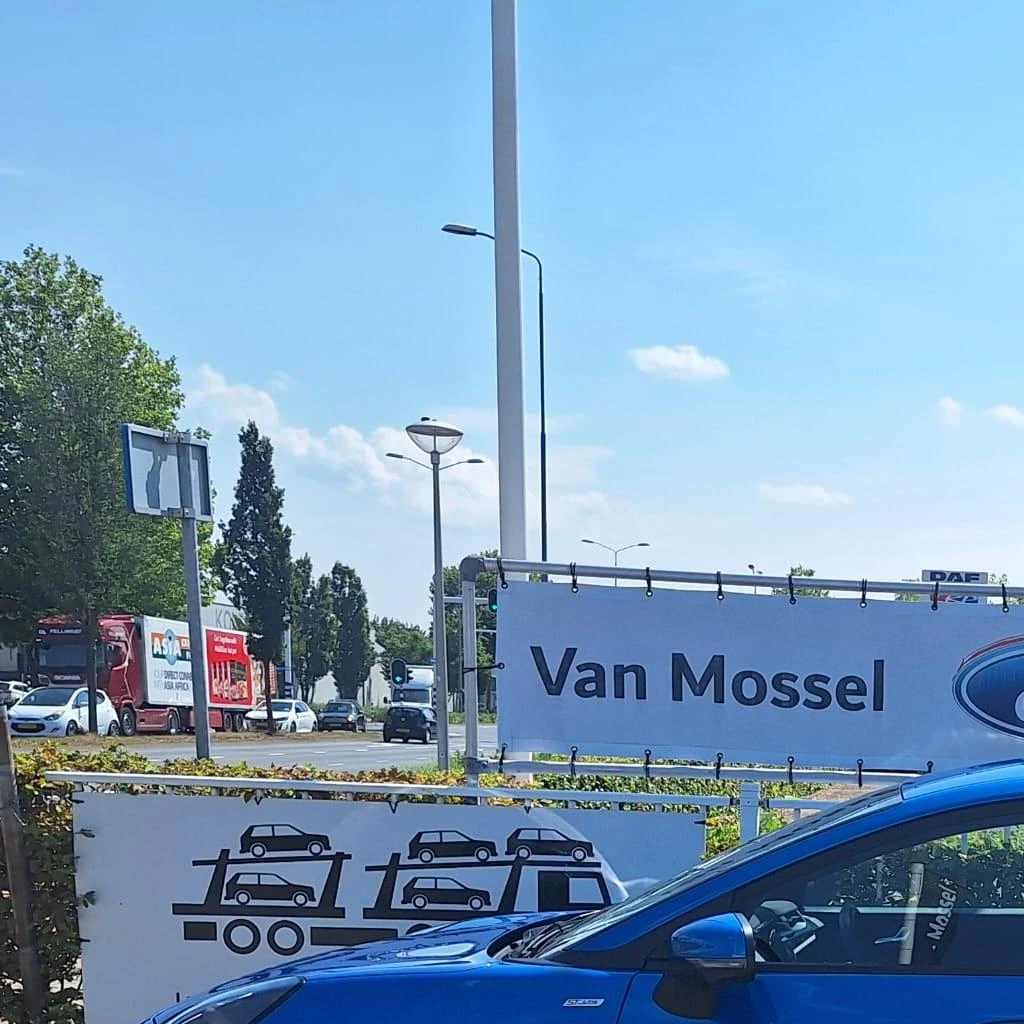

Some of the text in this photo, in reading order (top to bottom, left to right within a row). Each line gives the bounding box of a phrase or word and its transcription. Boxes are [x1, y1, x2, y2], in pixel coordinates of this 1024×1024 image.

[930, 572, 980, 583] DAF
[153, 636, 182, 657] ASIA
[530, 646, 885, 712] Van Mossel
[926, 883, 957, 941] Mossel
